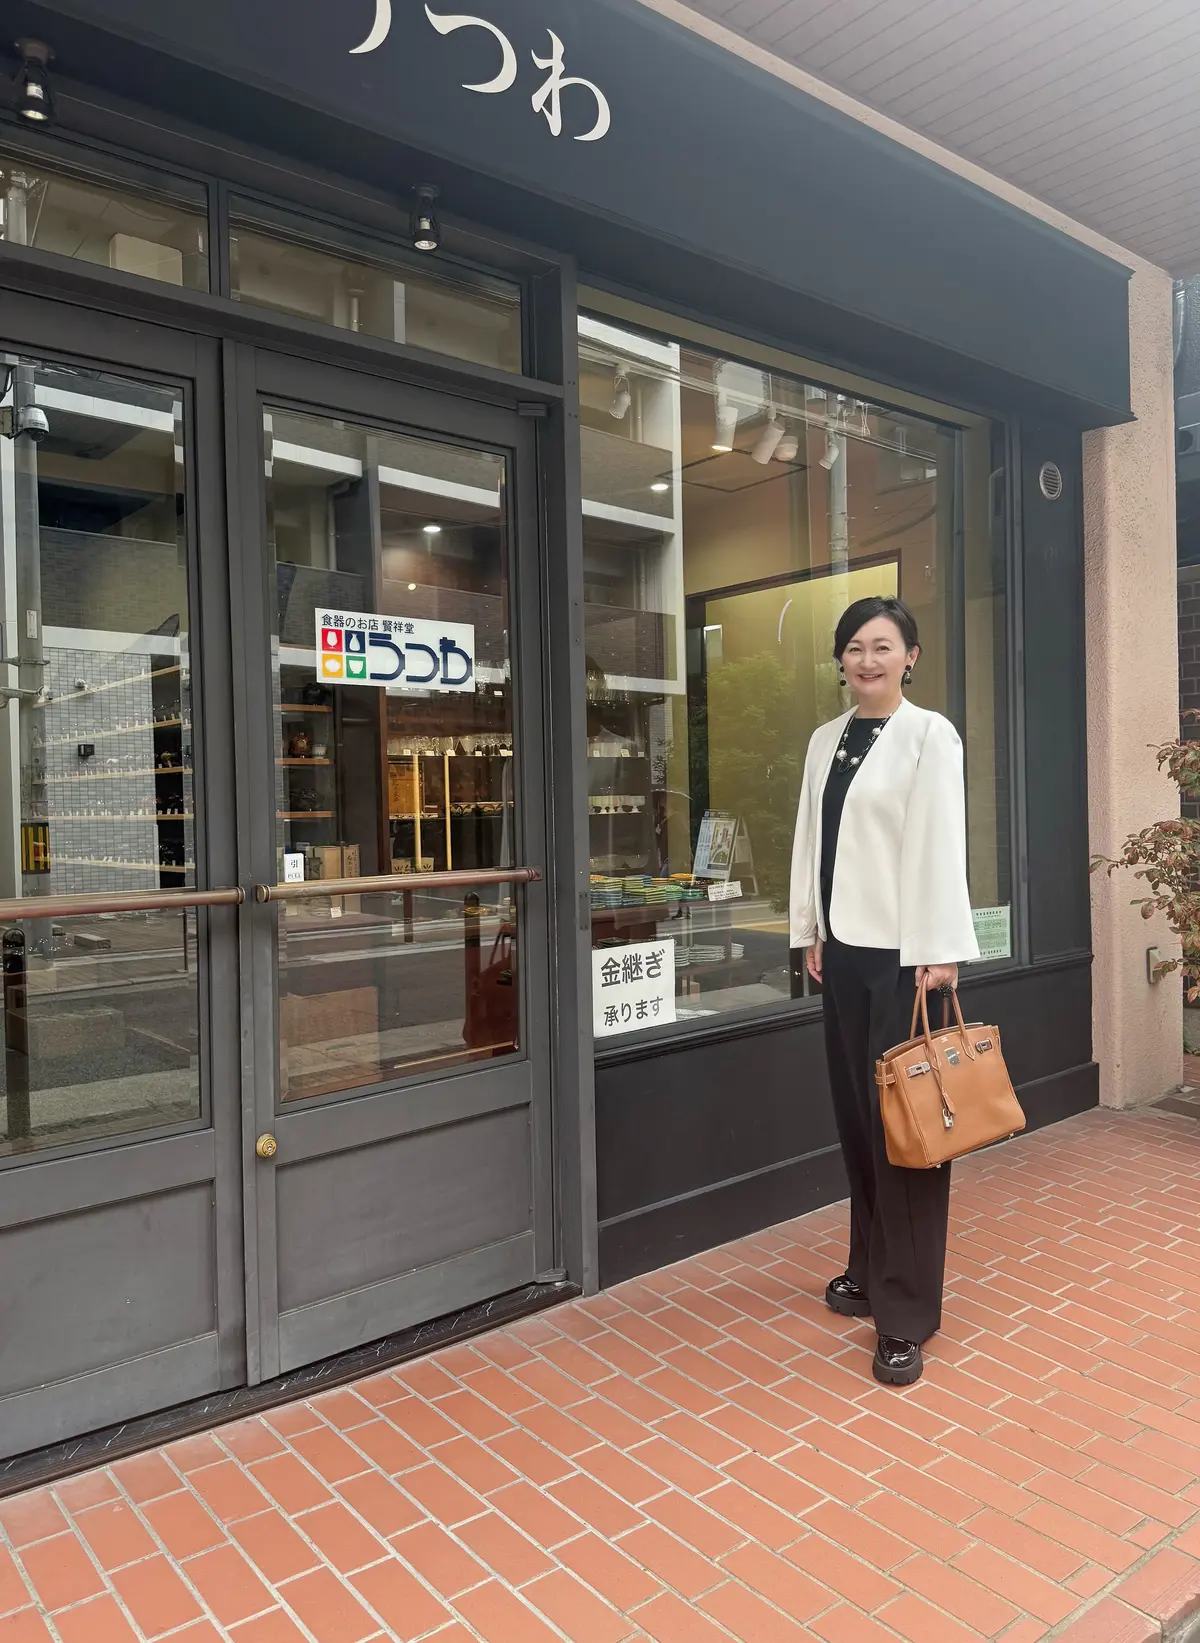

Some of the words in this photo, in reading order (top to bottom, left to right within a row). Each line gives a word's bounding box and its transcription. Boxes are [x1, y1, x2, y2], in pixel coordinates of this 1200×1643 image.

[321, 613, 379, 631] 食器のお店
[382, 619, 415, 634] 賢祥堂
[369, 632, 473, 685] うつわ
[601, 949, 665, 988] 金継ぎ
[604, 996, 664, 1027] 承ります
